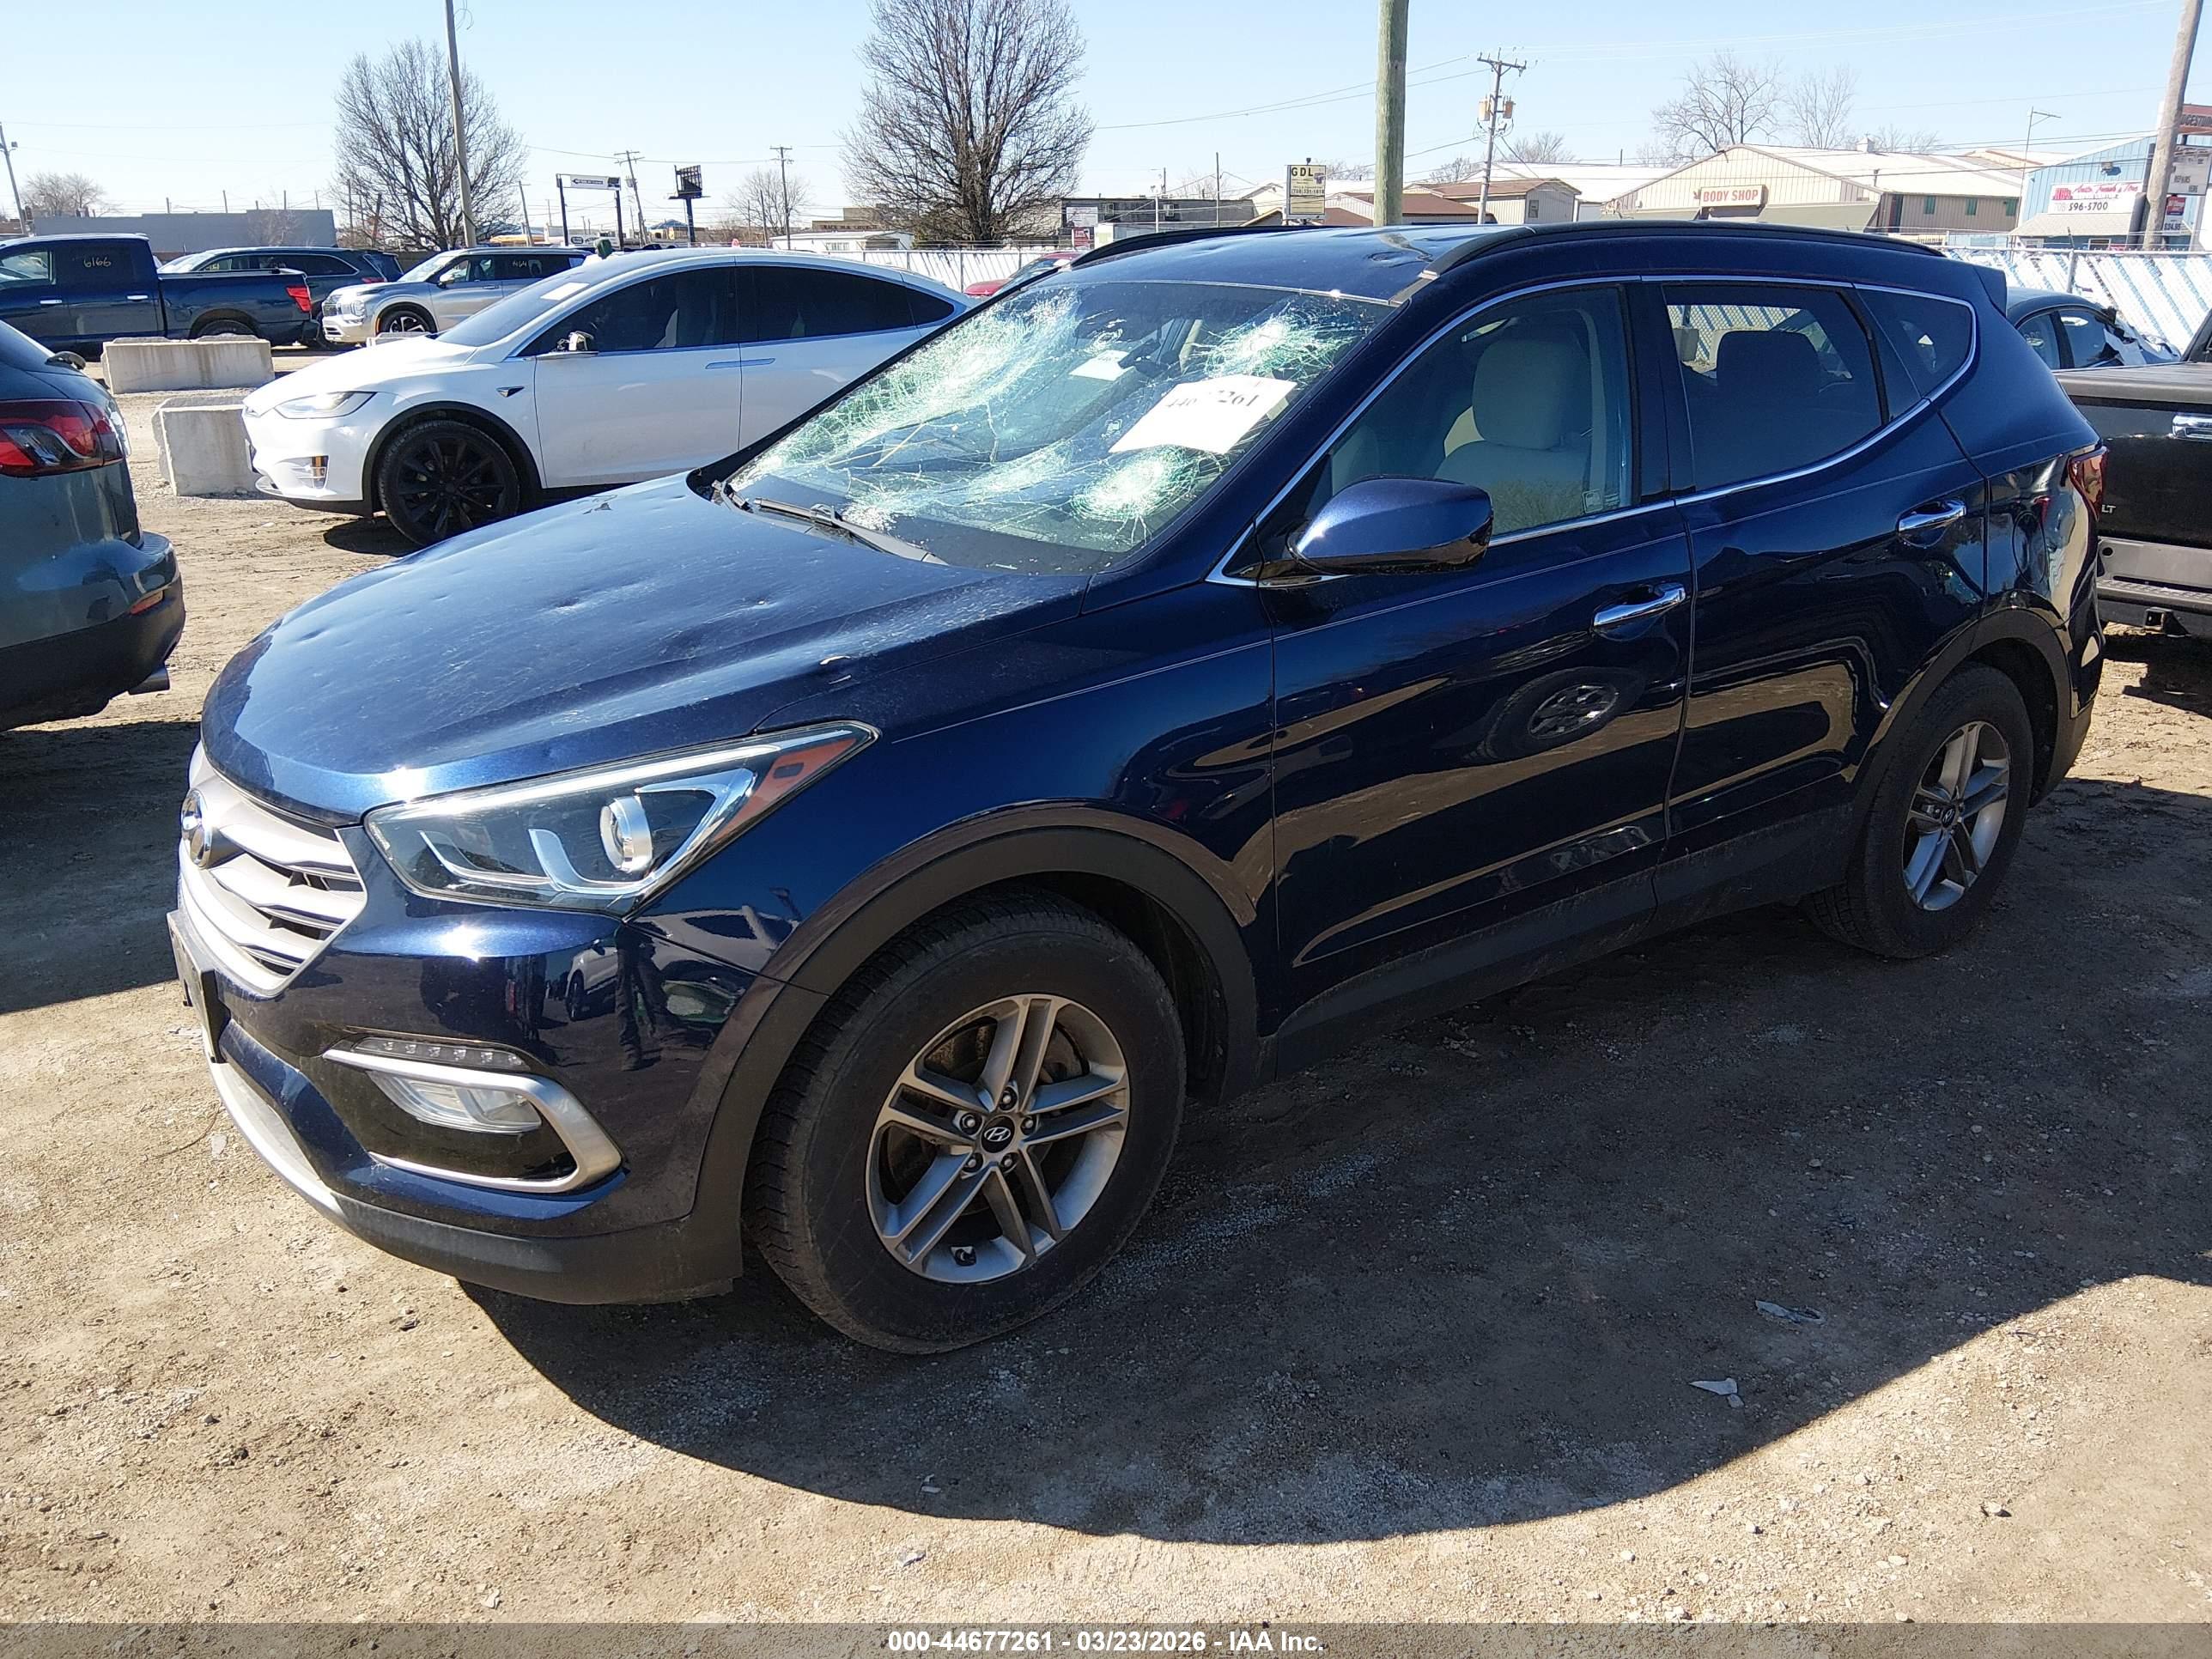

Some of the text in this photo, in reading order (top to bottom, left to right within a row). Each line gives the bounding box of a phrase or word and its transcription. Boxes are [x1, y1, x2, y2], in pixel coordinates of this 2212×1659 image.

[1291, 167, 1313, 176] GDL
[1704, 189, 1759, 202] BODY SHOP
[2069, 201, 2109, 211] 596-5700
[83, 257, 112, 268] 6166
